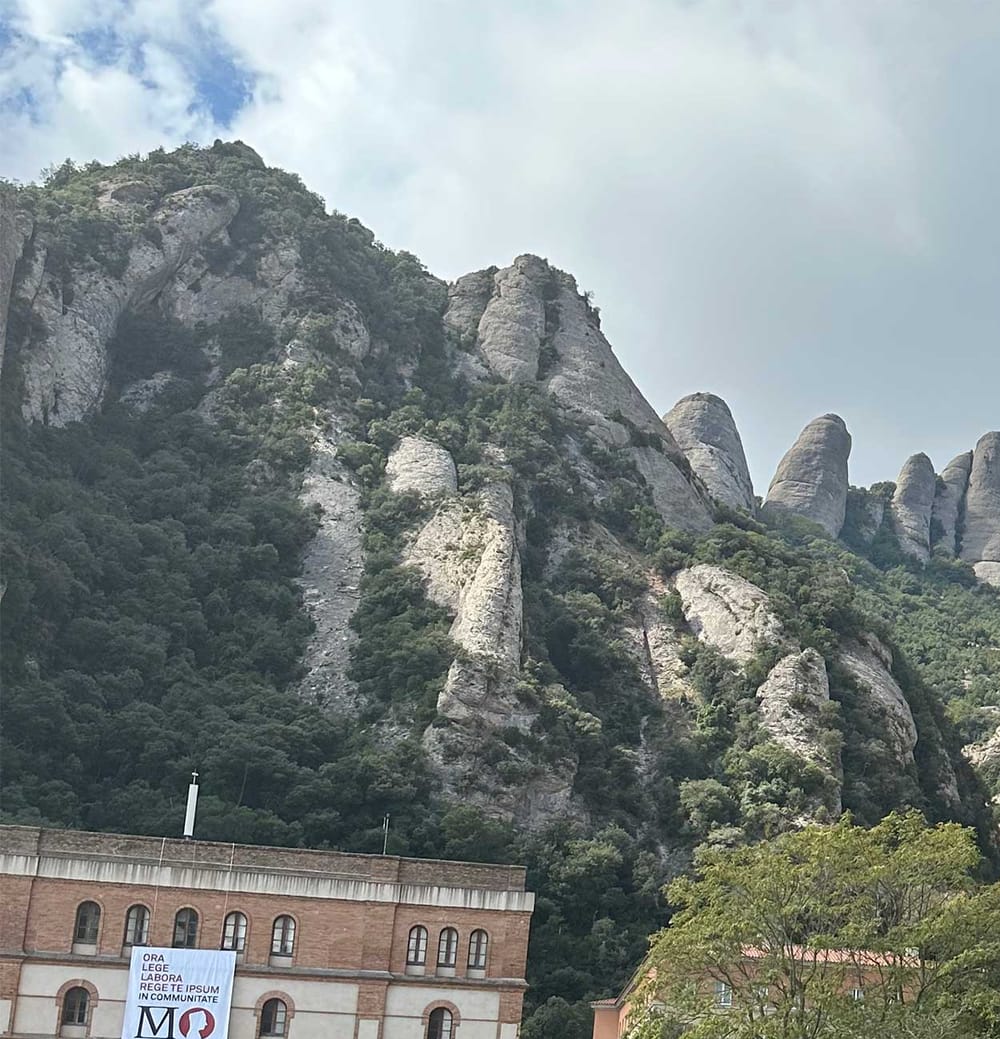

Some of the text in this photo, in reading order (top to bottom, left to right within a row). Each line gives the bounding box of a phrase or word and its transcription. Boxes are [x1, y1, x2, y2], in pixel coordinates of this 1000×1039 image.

[143, 953, 165, 962] ORA
[142, 963, 169, 972] LEGE
[140, 973, 183, 982] LABORA
[139, 982, 220, 994] REGE TE IPSUM
[138, 993, 219, 1004] IN COMMUNITATE
